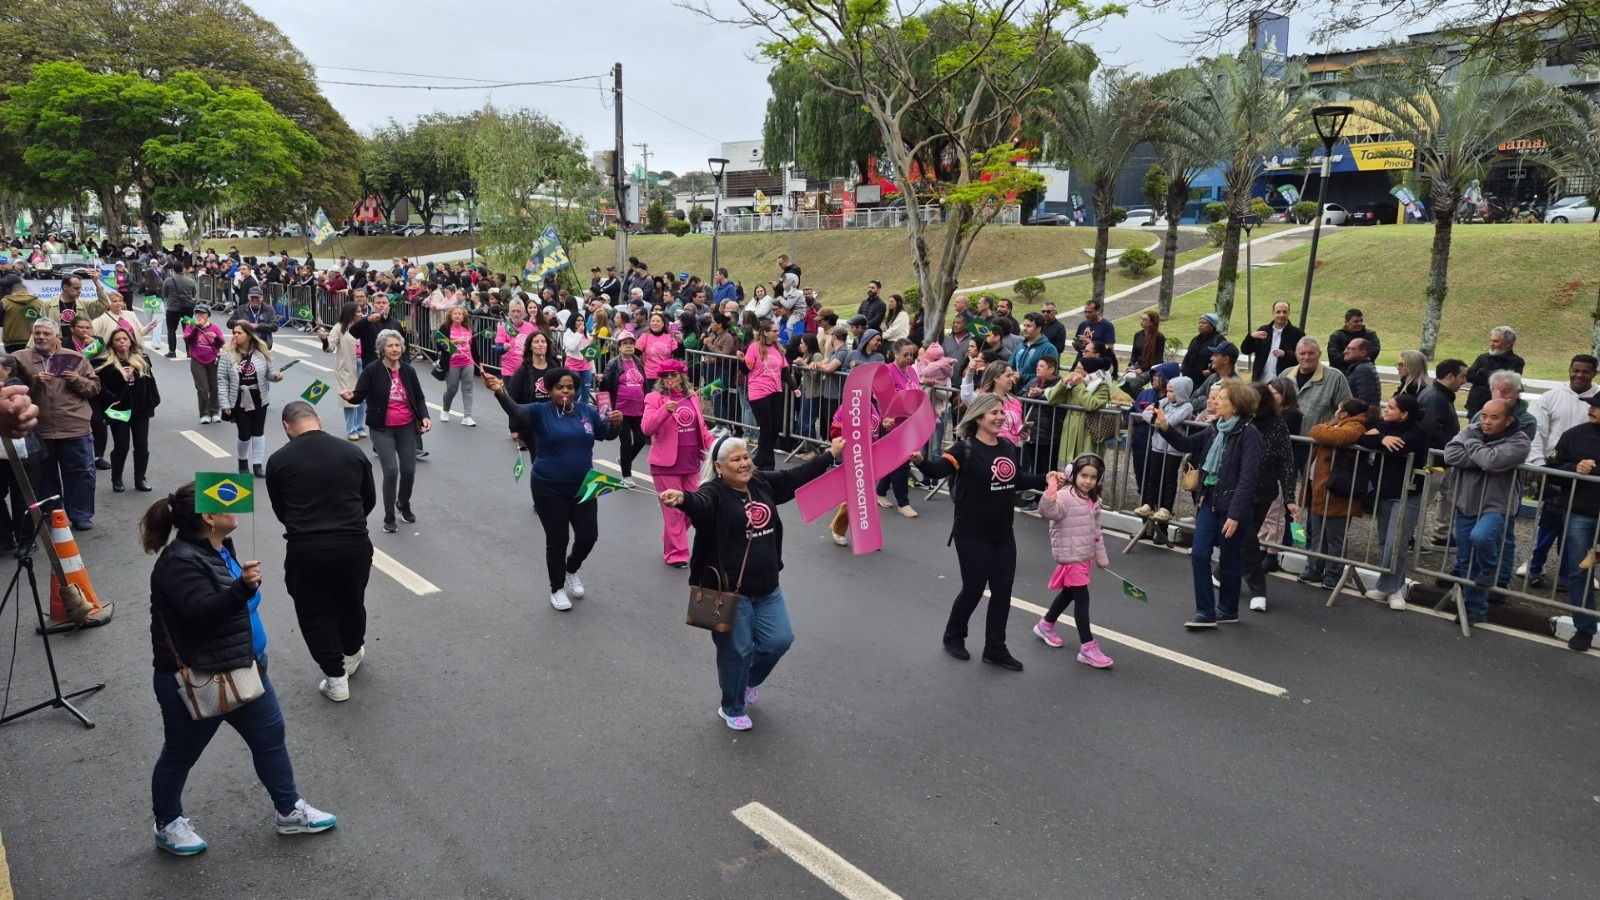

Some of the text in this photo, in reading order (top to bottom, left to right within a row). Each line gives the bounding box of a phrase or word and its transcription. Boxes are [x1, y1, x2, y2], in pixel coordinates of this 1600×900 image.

[1383, 160, 1410, 168] Pneus
[848, 389, 869, 530] Faça o autoexame
